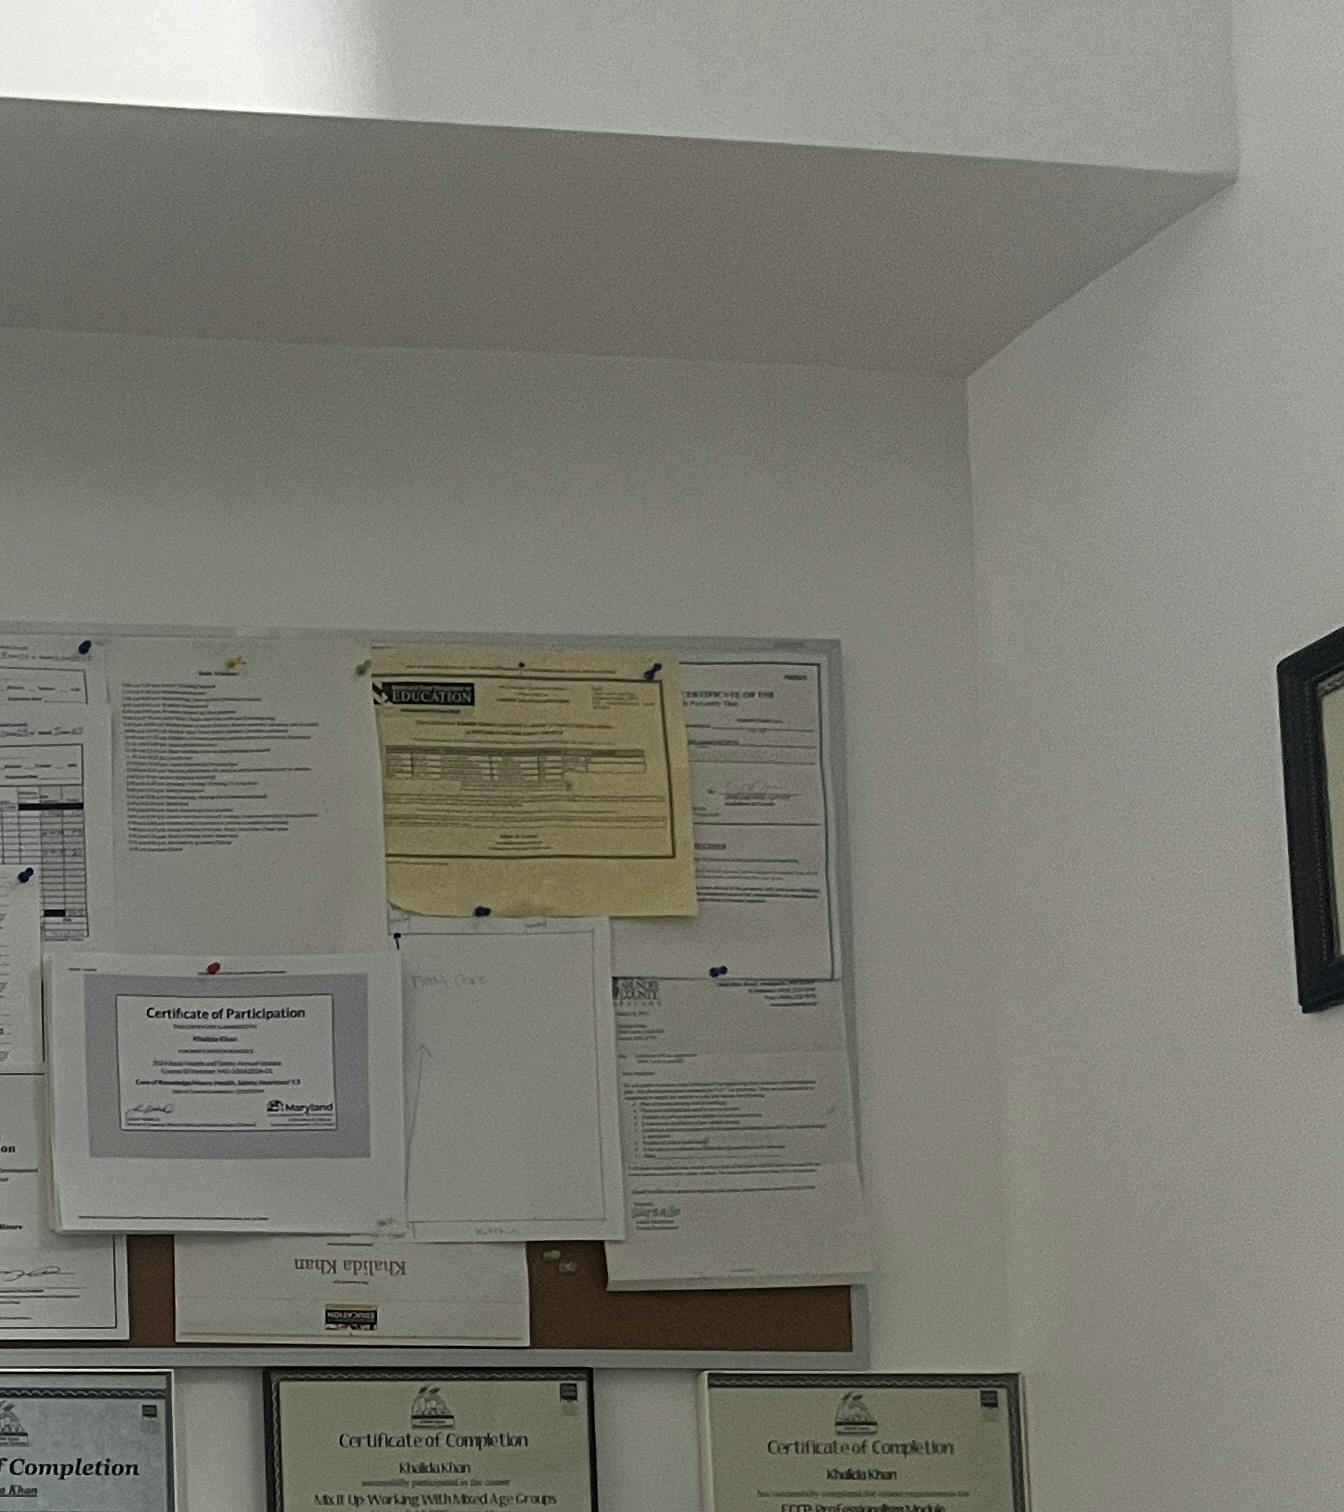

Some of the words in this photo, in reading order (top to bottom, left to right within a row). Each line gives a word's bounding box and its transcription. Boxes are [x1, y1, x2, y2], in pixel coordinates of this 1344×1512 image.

[393, 690, 472, 704] EDUCATION
[146, 1007, 209, 1019] Certificate
[211, 1006, 223, 1019] of
[226, 1007, 305, 1021] Participation
[285, 1103, 333, 1114] Maryland
[294, 1258, 338, 1274] Khan
[343, 1259, 406, 1275] Khalida
[339, 1433, 423, 1447] Certificate
[425, 1433, 441, 1447] of
[446, 1433, 528, 1450] Completion
[768, 1440, 850, 1455] Certificate
[851, 1440, 867, 1454] of
[872, 1440, 954, 1459] Completion
[10, 1459, 139, 1479] Completion
[399, 1462, 439, 1474] Khalida
[441, 1463, 470, 1474] Khan
[827, 1469, 866, 1480] Khalida
[868, 1469, 897, 1480] Khan
[9, 1485, 38, 1496] Khan
[368, 1493, 419, 1508] Working
[421, 1494, 451, 1505] With
[490, 1494, 515, 1507] Age
[516, 1494, 557, 1506] Groups
